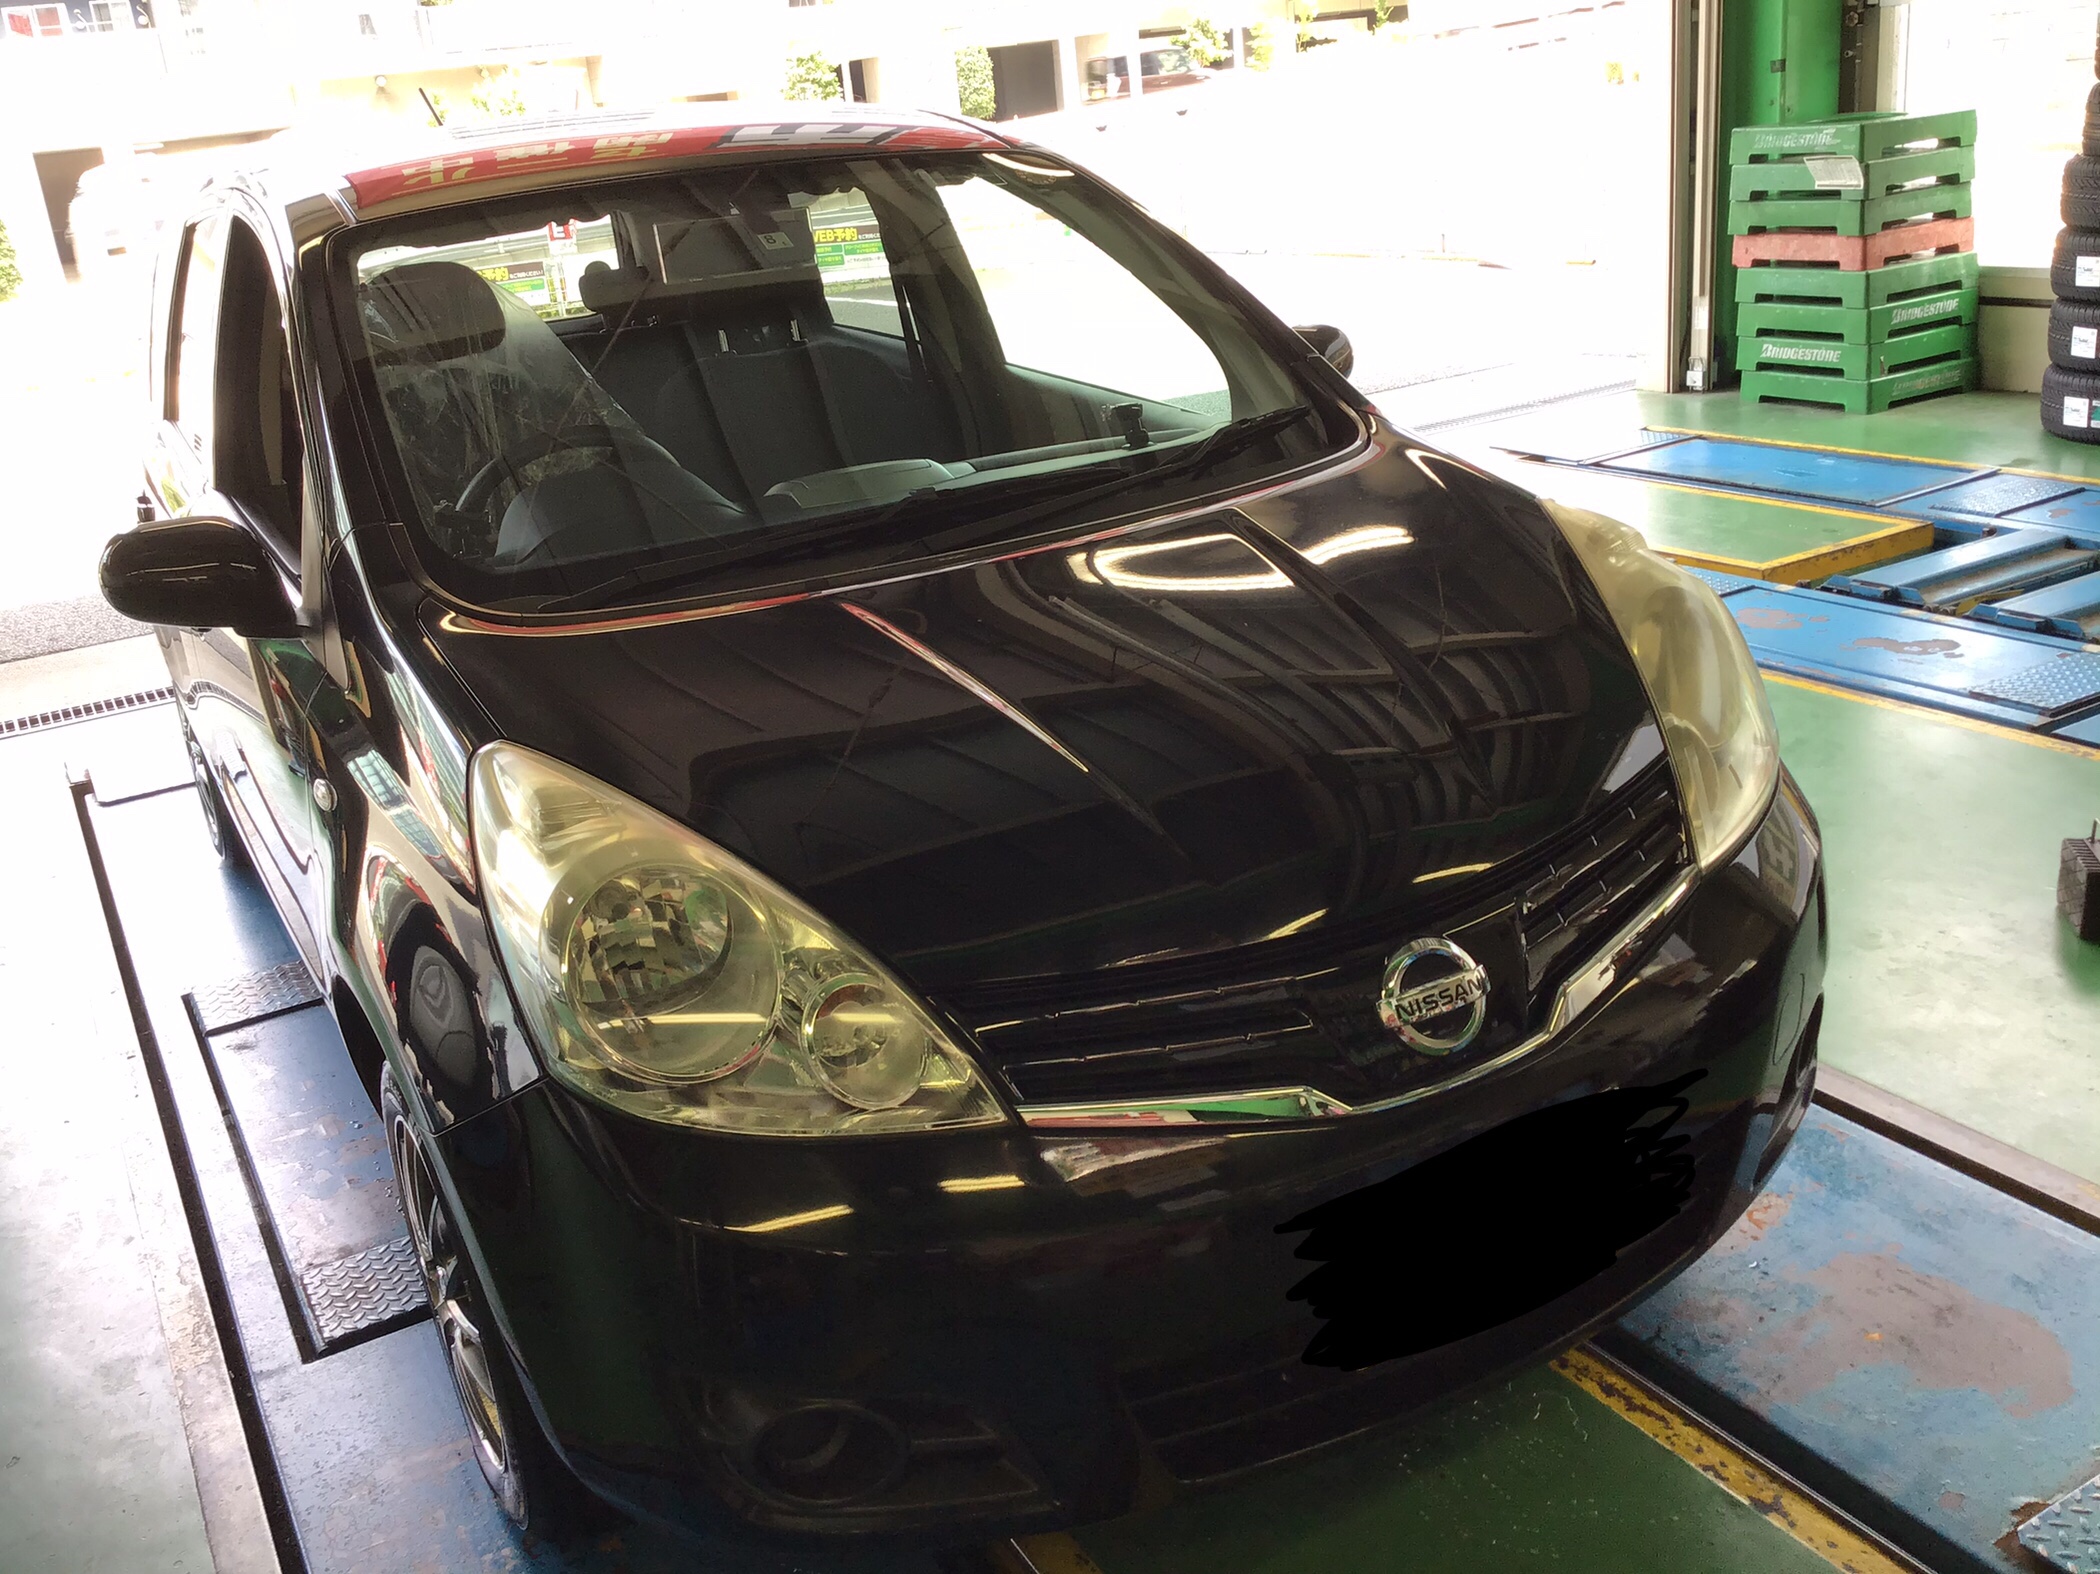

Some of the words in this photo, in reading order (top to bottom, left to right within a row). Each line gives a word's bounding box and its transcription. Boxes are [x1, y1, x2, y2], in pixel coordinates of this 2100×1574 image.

[1891, 299, 1959, 324] BRIDGESTONE
[1760, 343, 1842, 362] BRIDGESTONE
[1395, 977, 1484, 1019] NISSAN
